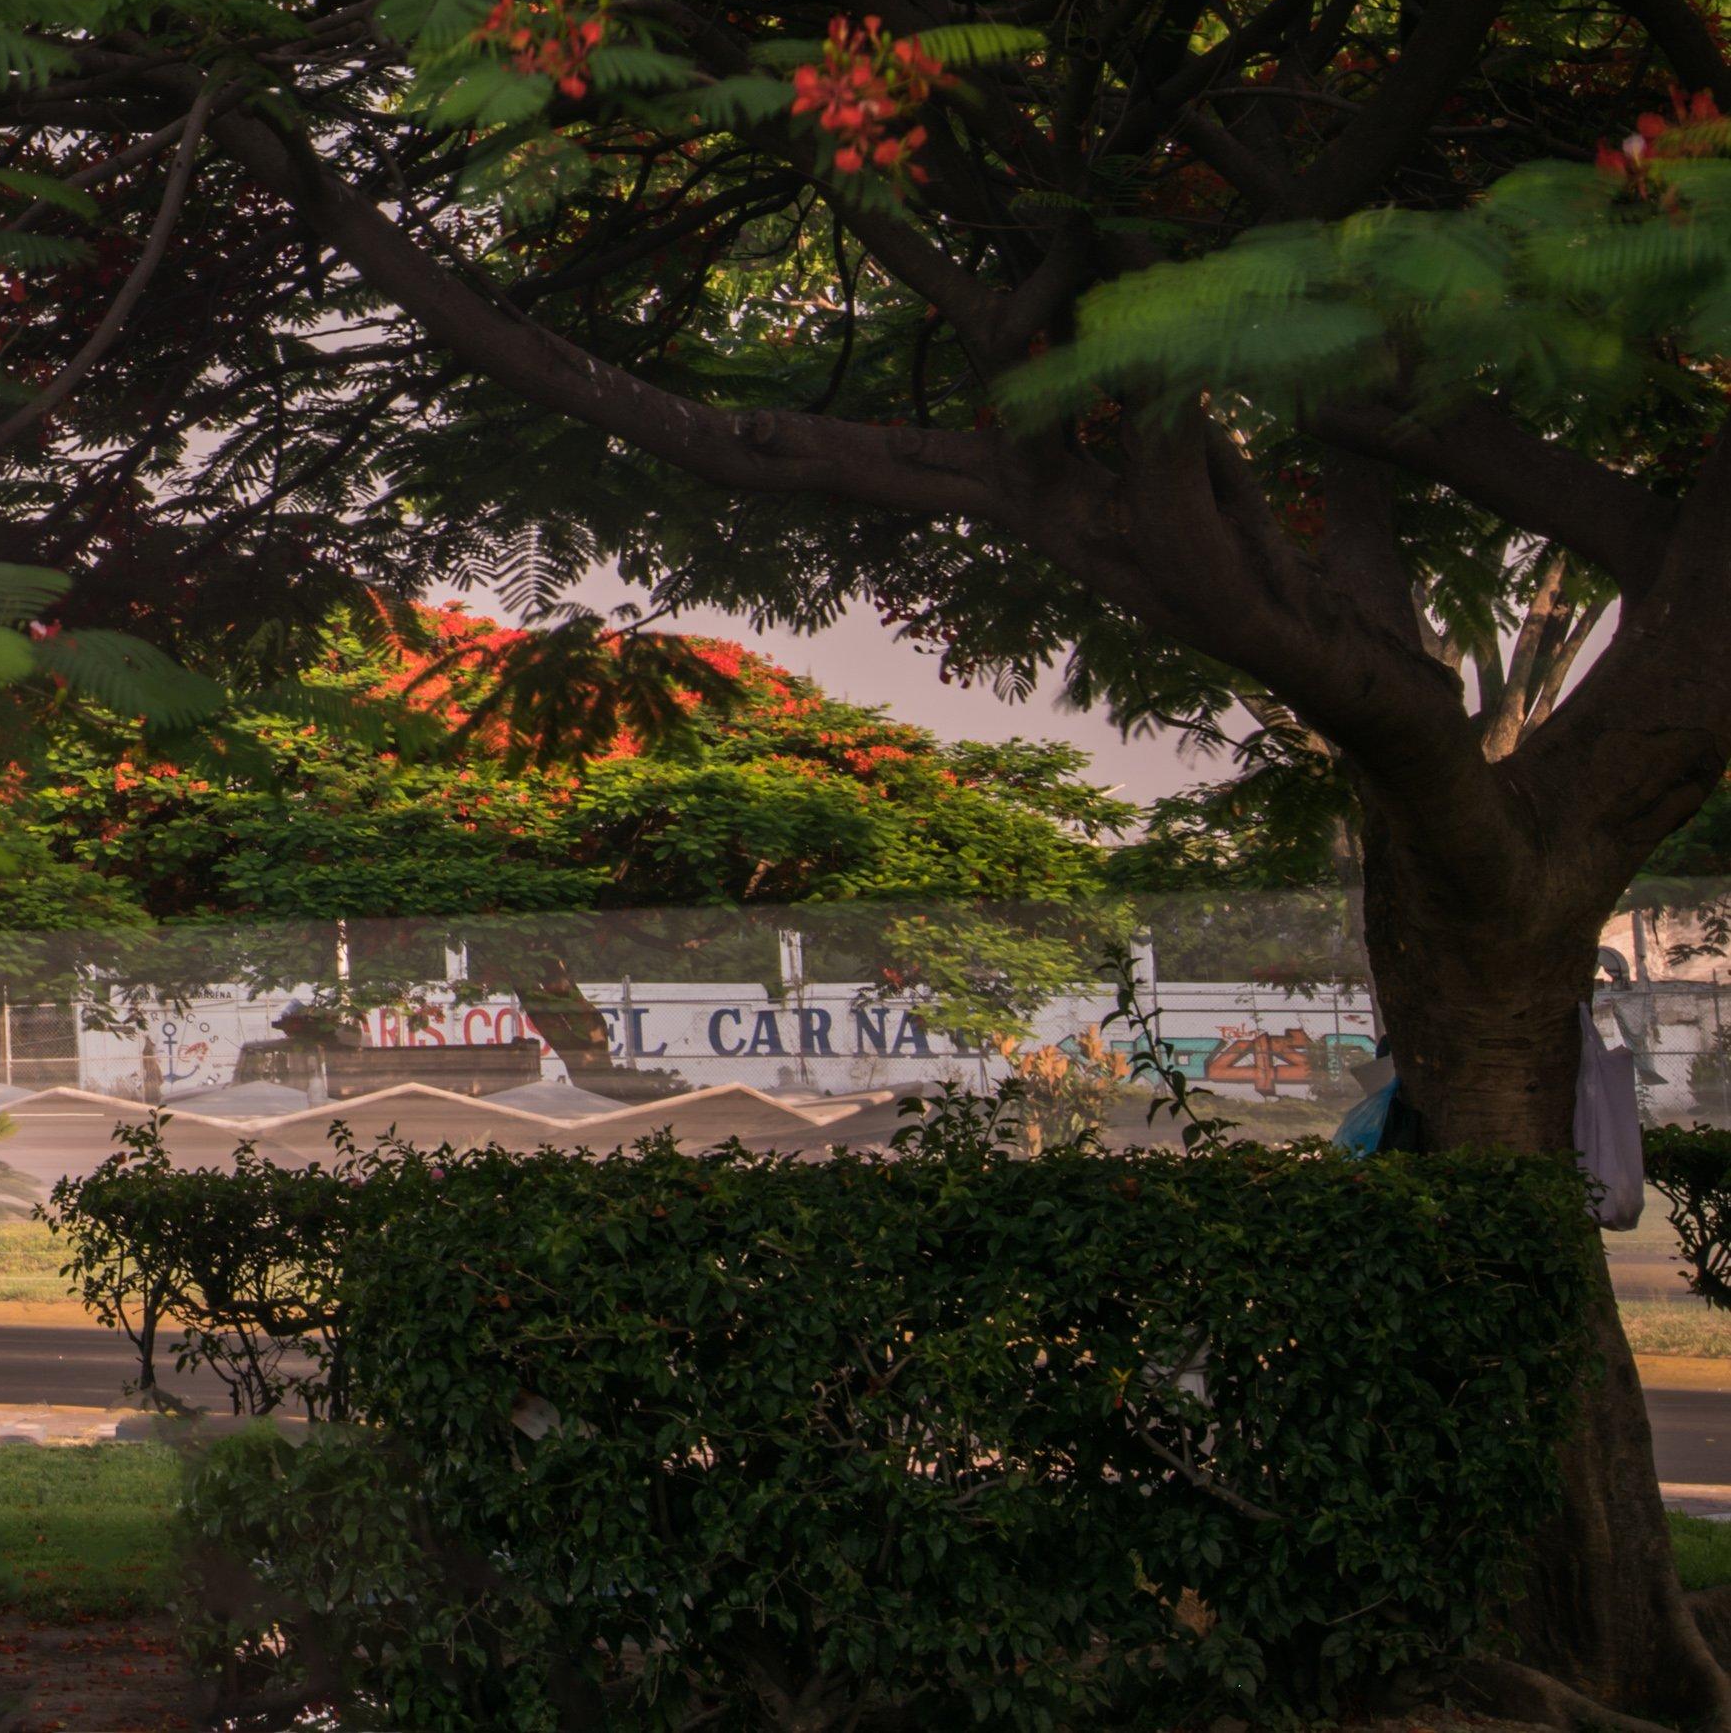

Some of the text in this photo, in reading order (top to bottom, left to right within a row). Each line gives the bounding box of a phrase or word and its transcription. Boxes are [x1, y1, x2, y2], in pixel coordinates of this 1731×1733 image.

[360, 1006, 991, 1058] ARISCOS EL CARNA
